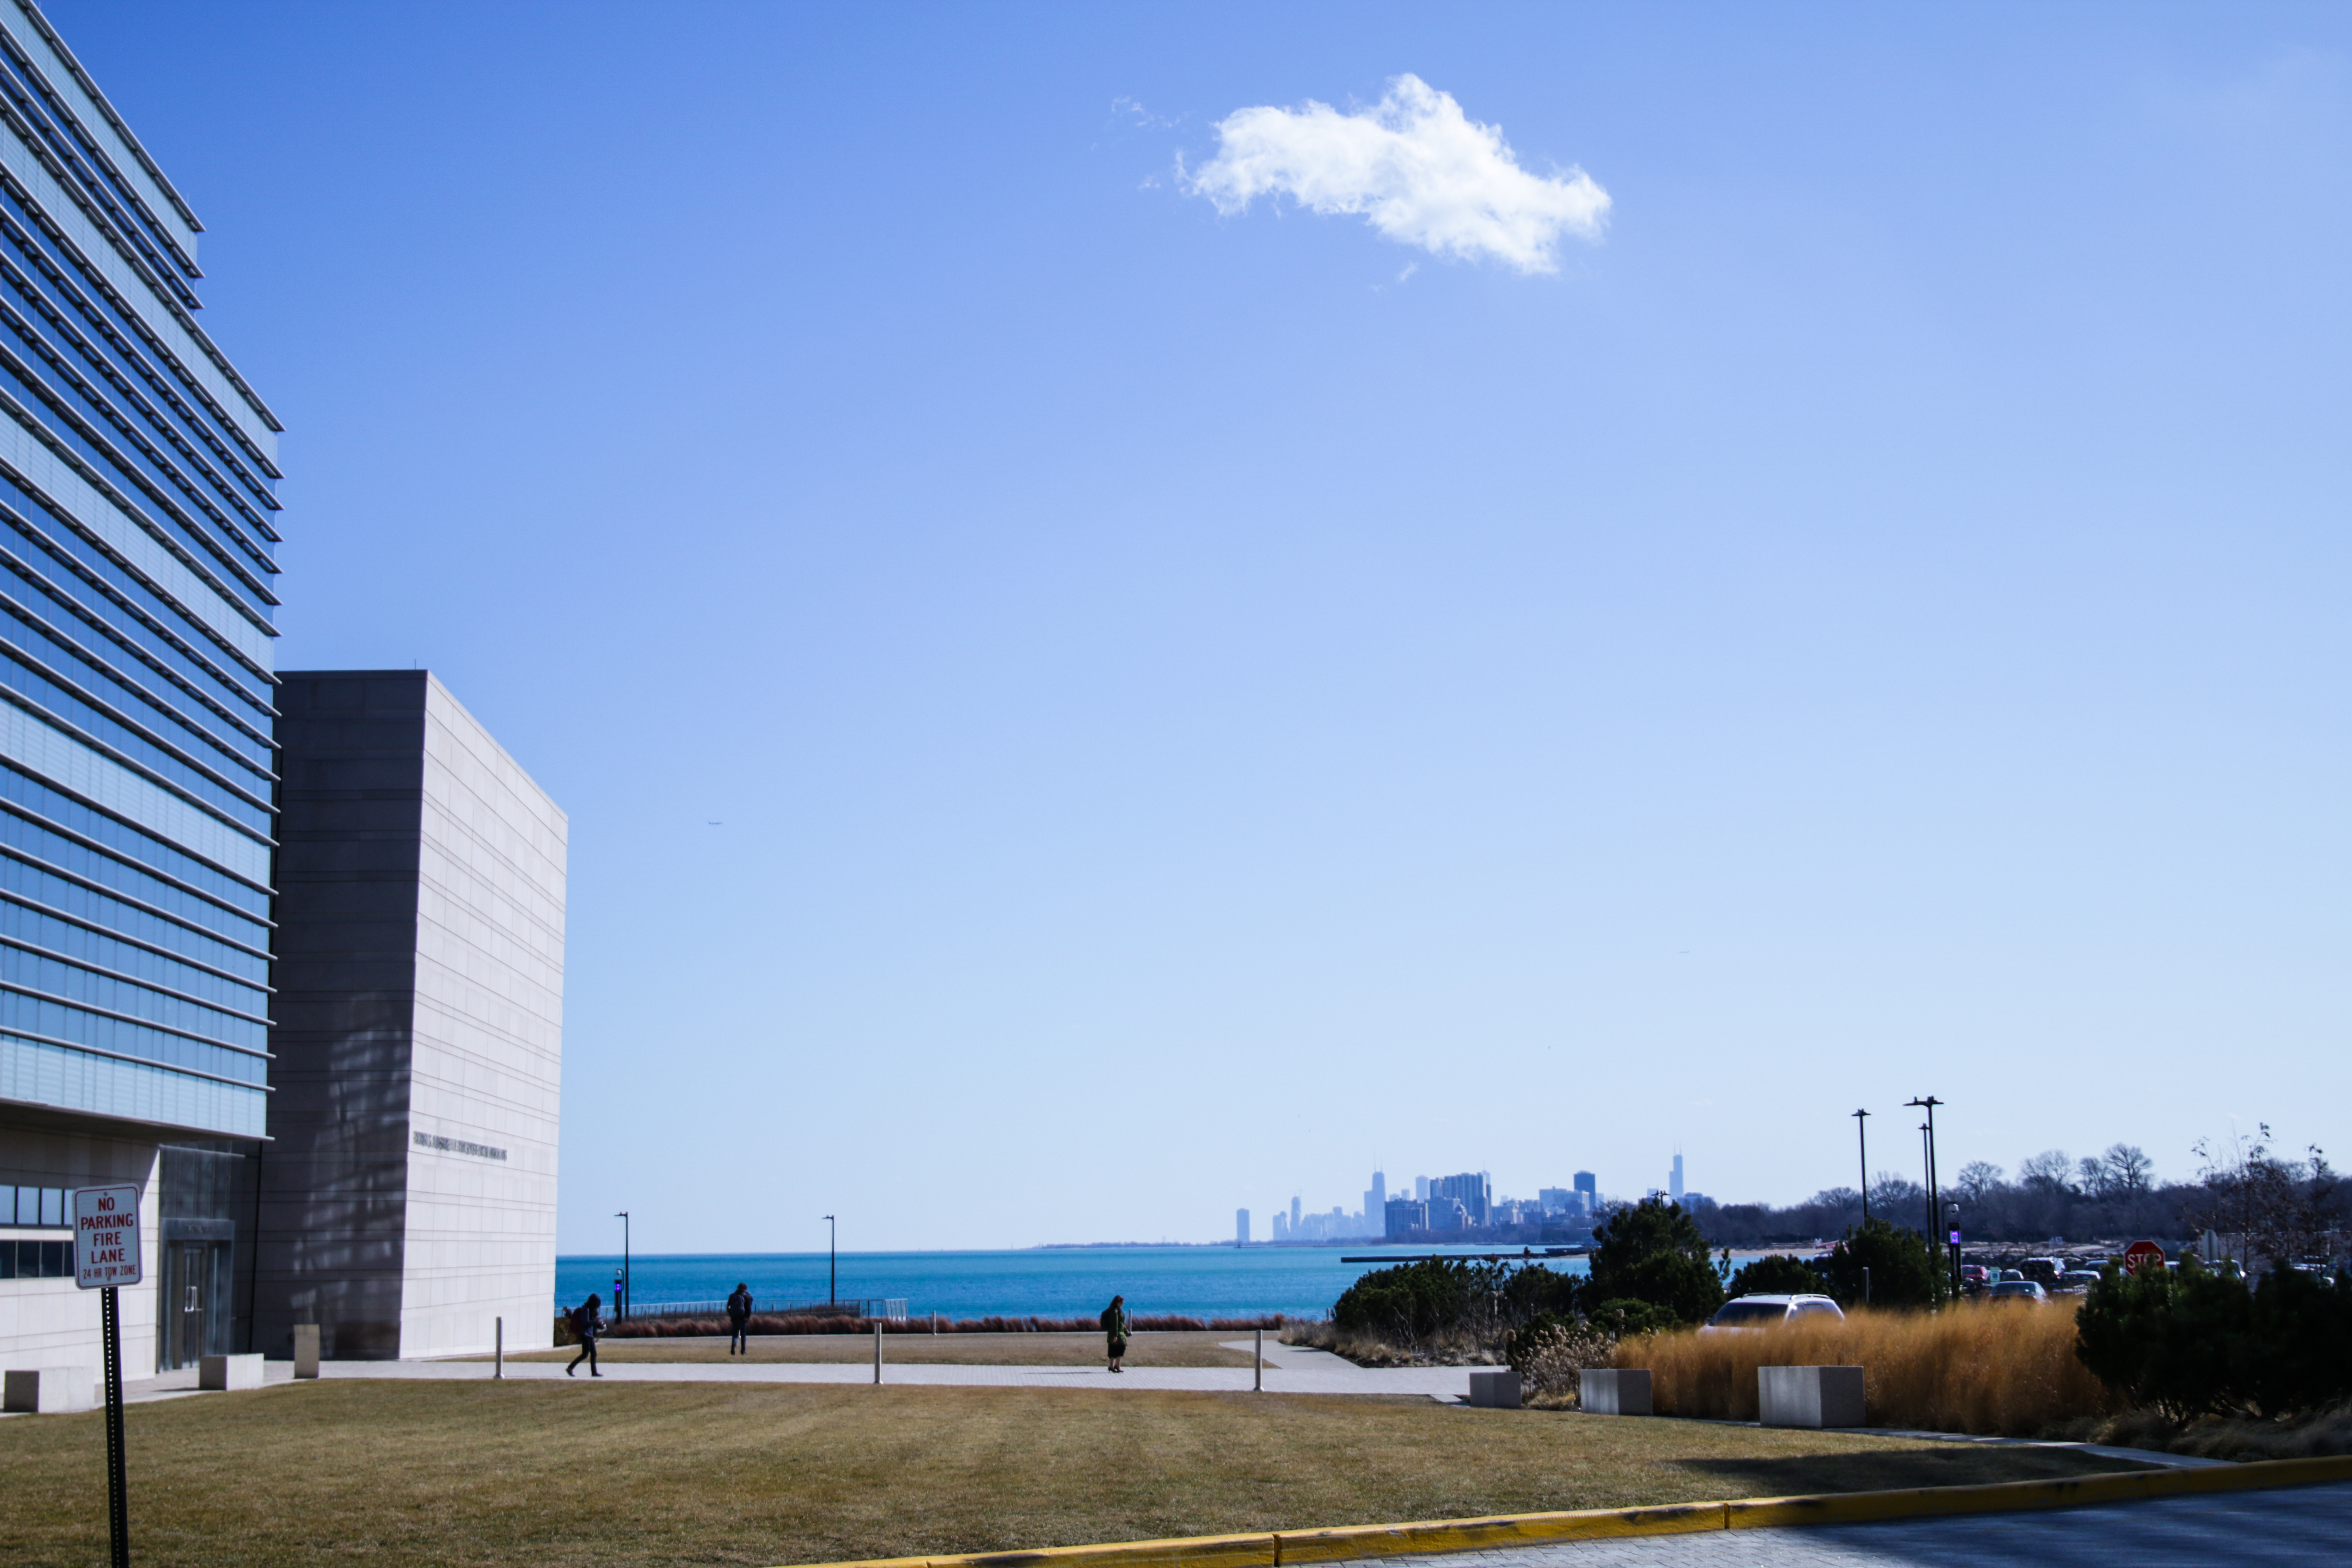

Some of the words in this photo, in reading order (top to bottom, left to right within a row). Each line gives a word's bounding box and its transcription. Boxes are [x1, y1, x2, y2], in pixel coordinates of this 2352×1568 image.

[98, 1197, 115, 1211] NO
[81, 1213, 133, 1230] PARKING
[94, 1232, 122, 1246] FIRE
[91, 1248, 126, 1264] LANE
[83, 1269, 91, 1279] 24
[94, 1268, 102, 1278] HR
[105, 1266, 116, 1277] TOW
[120, 1265, 136, 1276] ZONE
